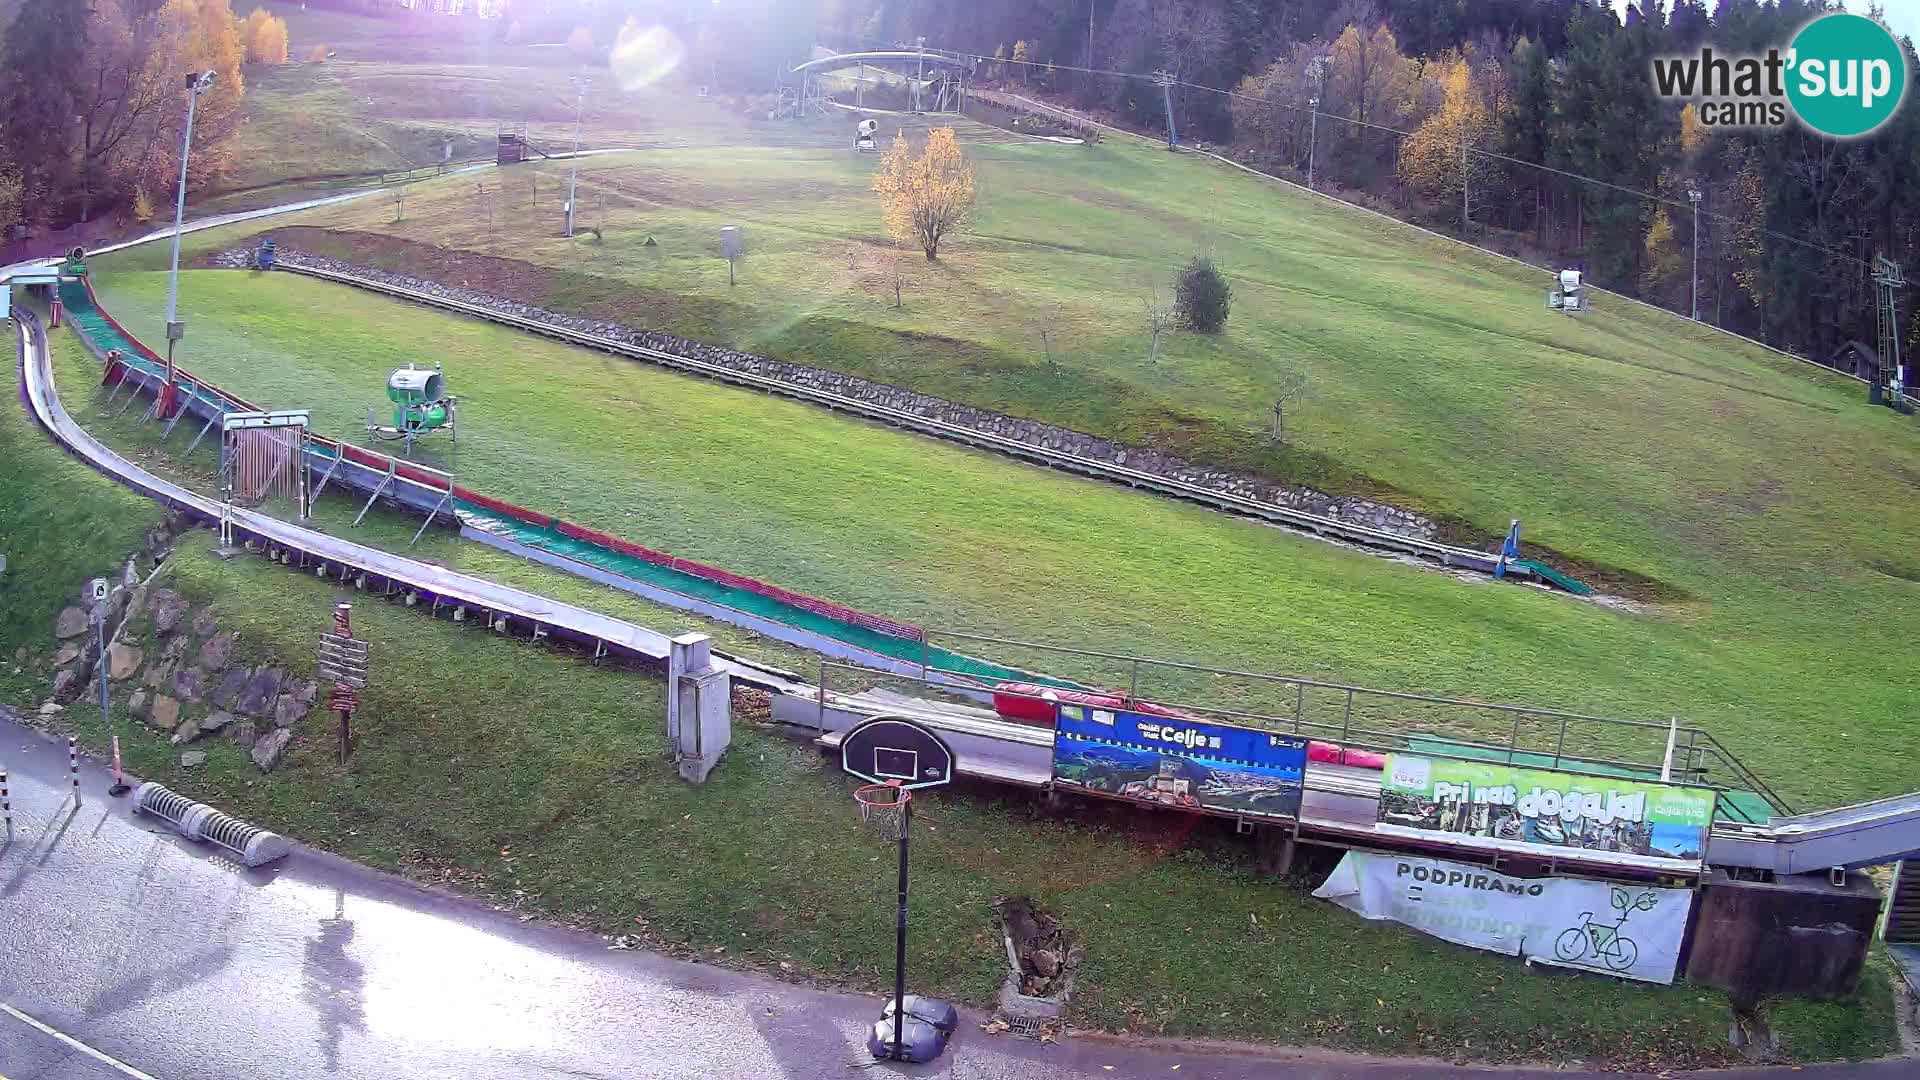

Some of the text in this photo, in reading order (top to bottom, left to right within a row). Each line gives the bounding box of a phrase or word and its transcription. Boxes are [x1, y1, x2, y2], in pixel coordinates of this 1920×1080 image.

[1160, 726, 1207, 749] Celje
[1433, 780, 1471, 804] Pri
[1474, 784, 1517, 806] nas
[1396, 862, 1545, 897] PODPIRAMO
